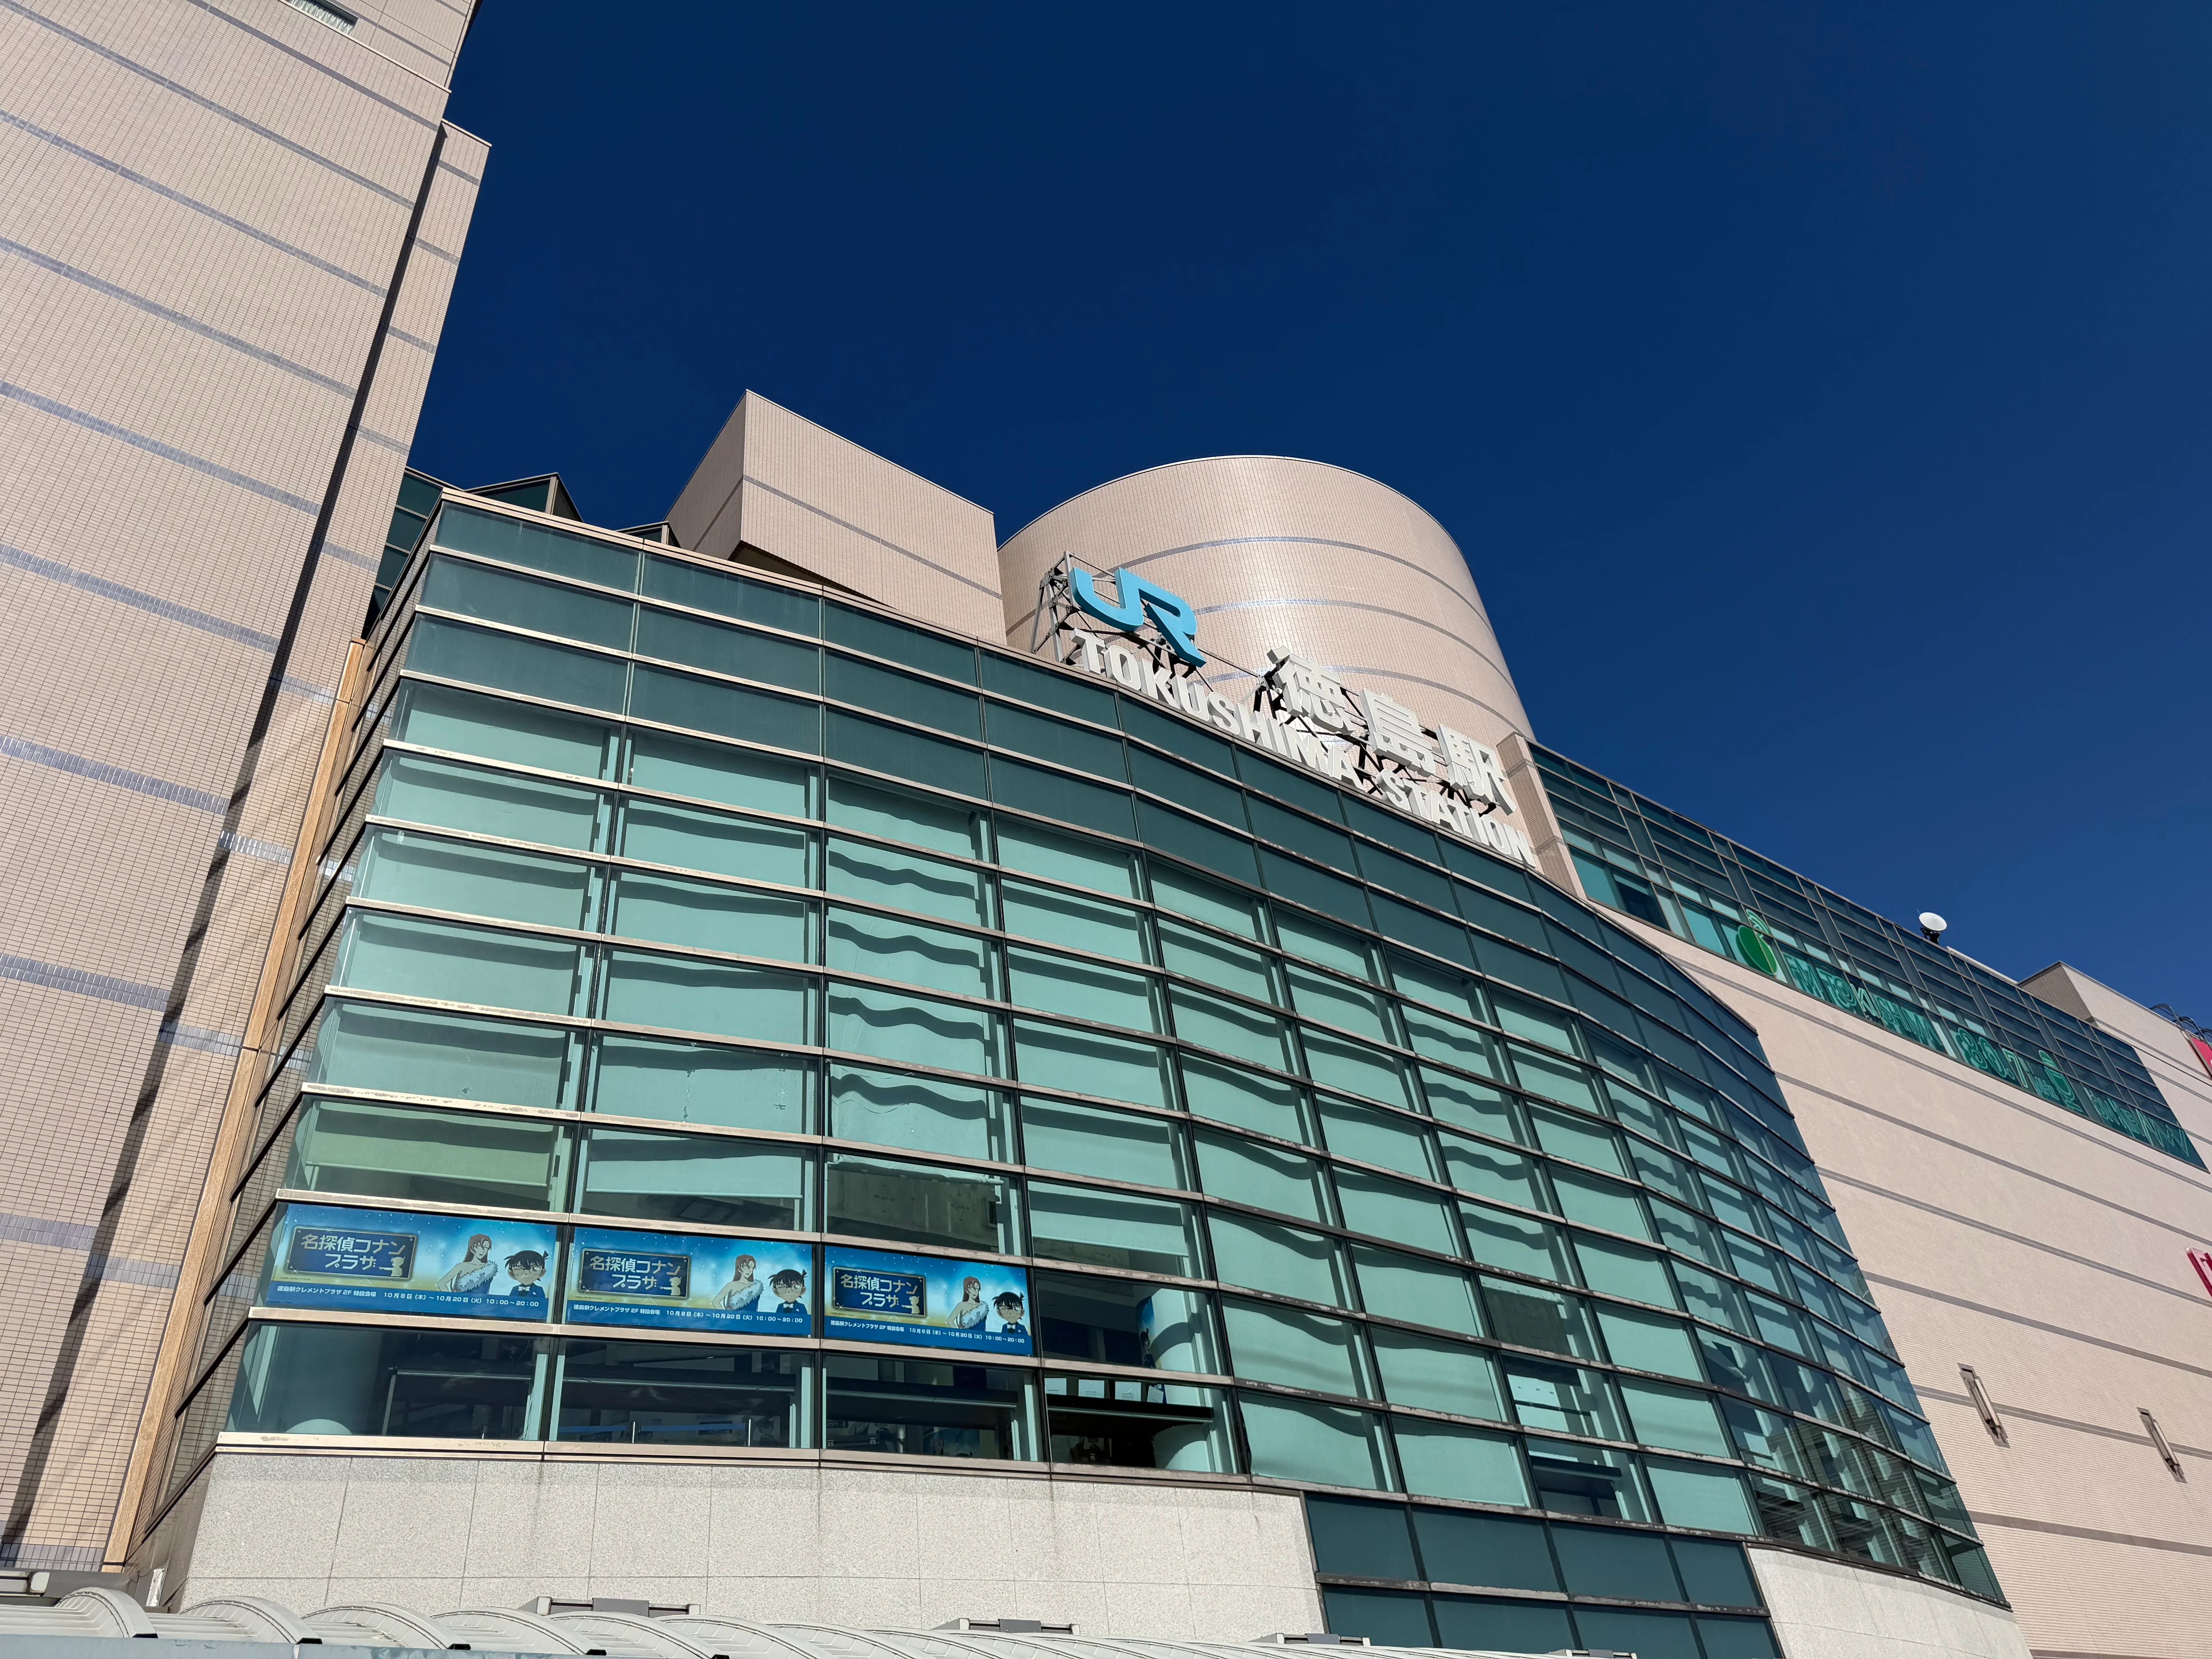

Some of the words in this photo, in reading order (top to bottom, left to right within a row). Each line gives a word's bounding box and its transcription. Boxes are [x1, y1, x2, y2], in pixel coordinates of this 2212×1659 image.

[1068, 566, 1207, 668] JR
[1267, 645, 1516, 815] 徳島駅
[1070, 628, 1364, 790] TOKUSHIMA
[1376, 769, 1537, 868] STATION
[1783, 953, 1824, 996] FM
[301, 1234, 405, 1255] 名探偵コナン
[325, 1253, 377, 1270] プラザ
[590, 1255, 681, 1275] 名探偵コナン
[612, 1274, 657, 1290] プラザ
[841, 1274, 918, 1295] 名探偵コナン
[860, 1292, 899, 1308] プラザ
